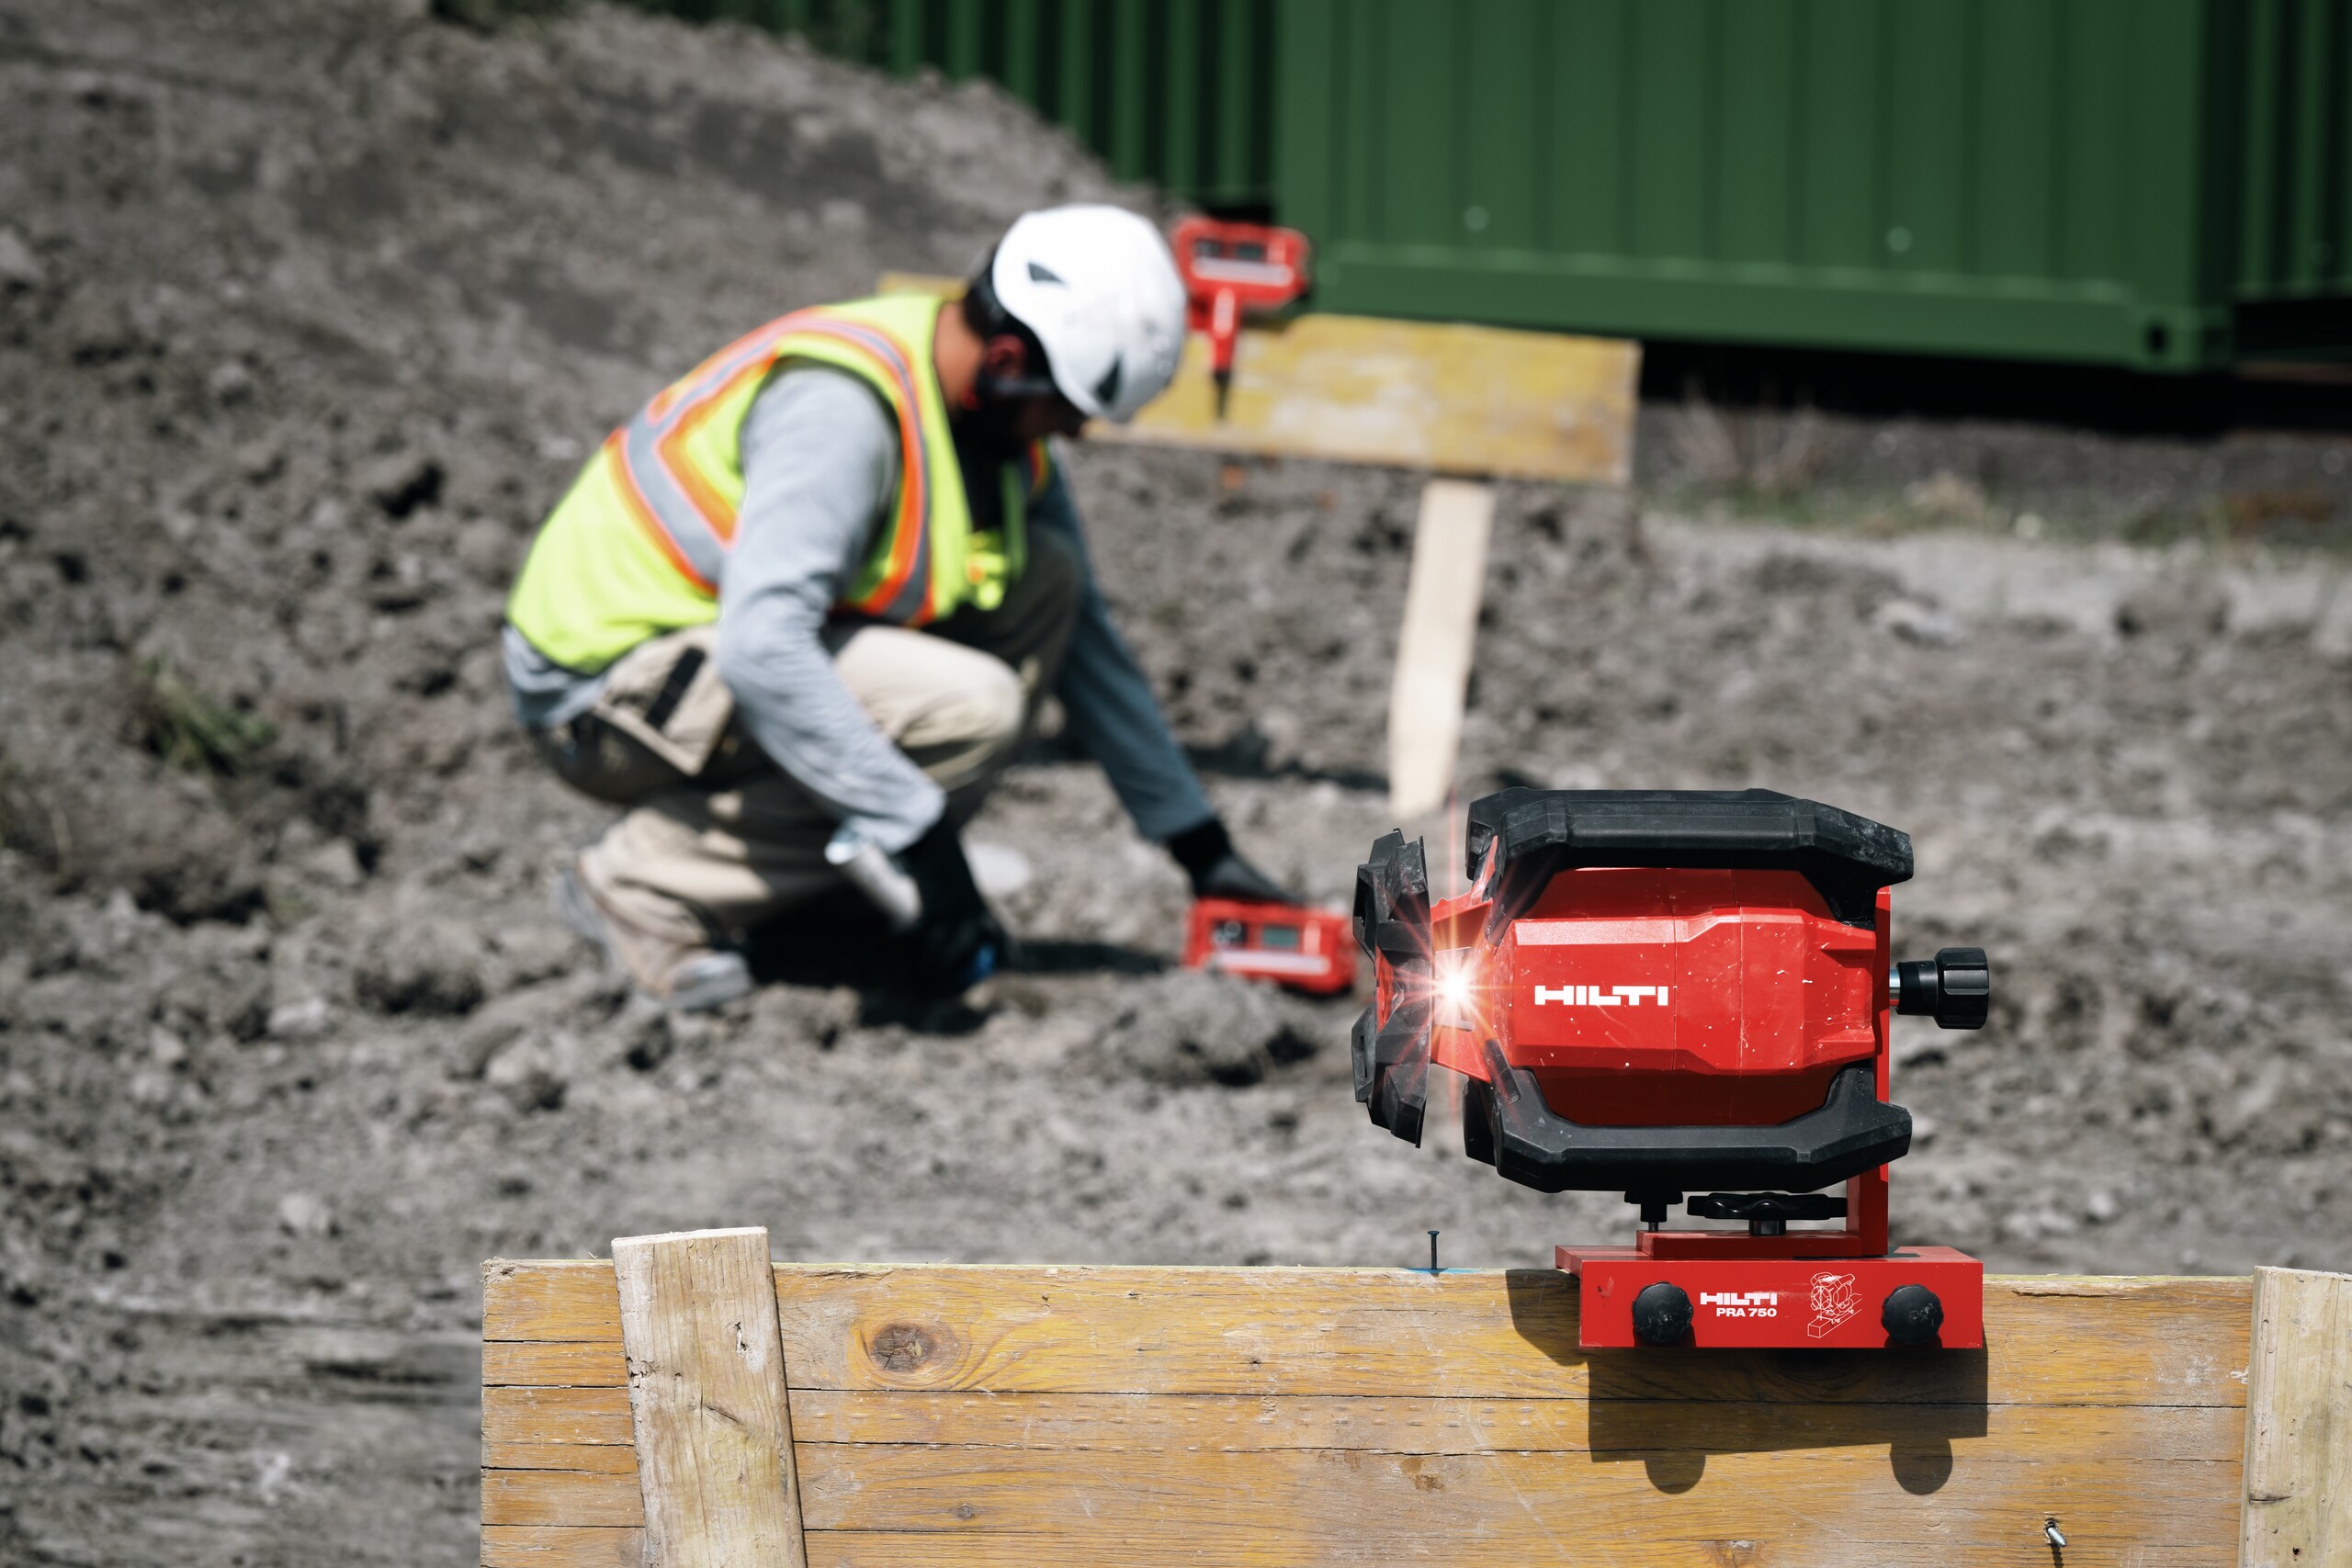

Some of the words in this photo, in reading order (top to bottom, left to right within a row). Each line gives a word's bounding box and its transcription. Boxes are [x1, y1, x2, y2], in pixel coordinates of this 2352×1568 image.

[1534, 985, 1668, 1006] HILTI
[1700, 1292, 1778, 1305] HILTI
[1716, 1307, 1746, 1317] PRA
[1747, 1307, 1778, 1317] 750
